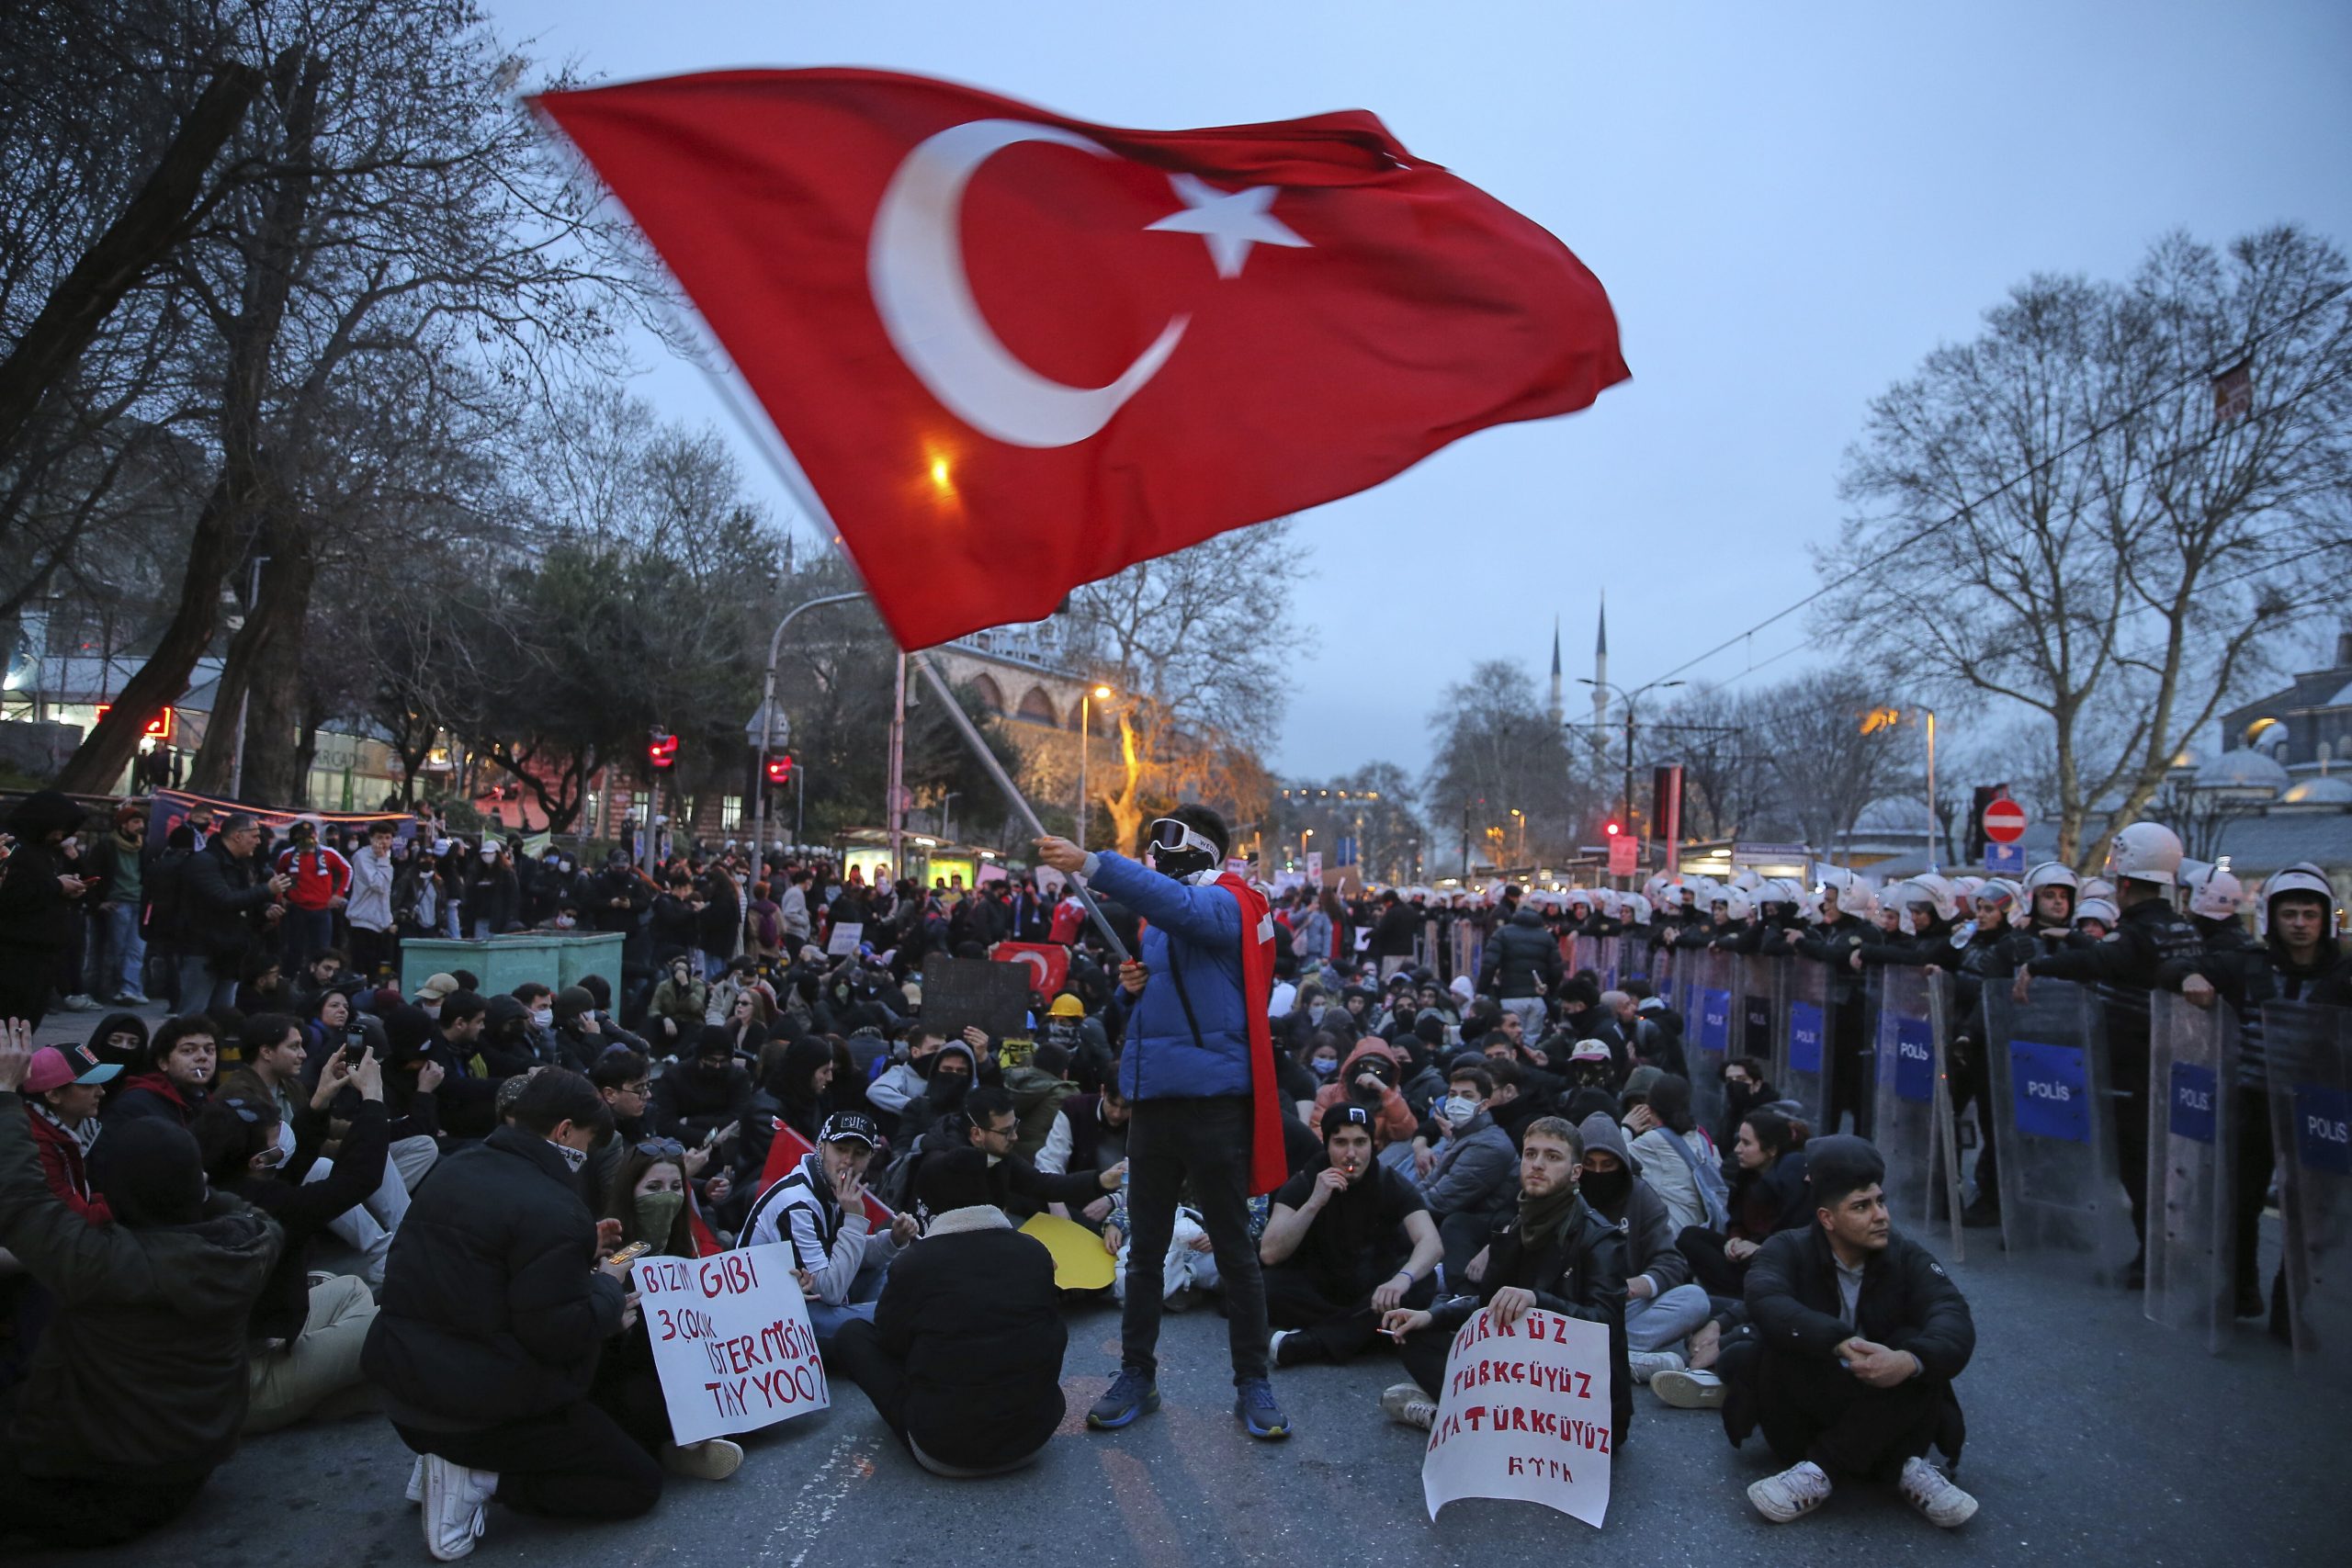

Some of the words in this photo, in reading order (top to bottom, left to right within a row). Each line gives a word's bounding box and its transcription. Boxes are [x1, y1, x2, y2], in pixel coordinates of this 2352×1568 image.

[2028, 1080, 2071, 1101] POLİS
[642, 1262, 694, 1293] BİZİM
[699, 1251, 759, 1299] GİBİ
[657, 1309, 676, 1341] 3
[703, 1335, 763, 1375] İSTER
[1453, 1359, 1592, 1399] TÜRKÇÜYÜZ
